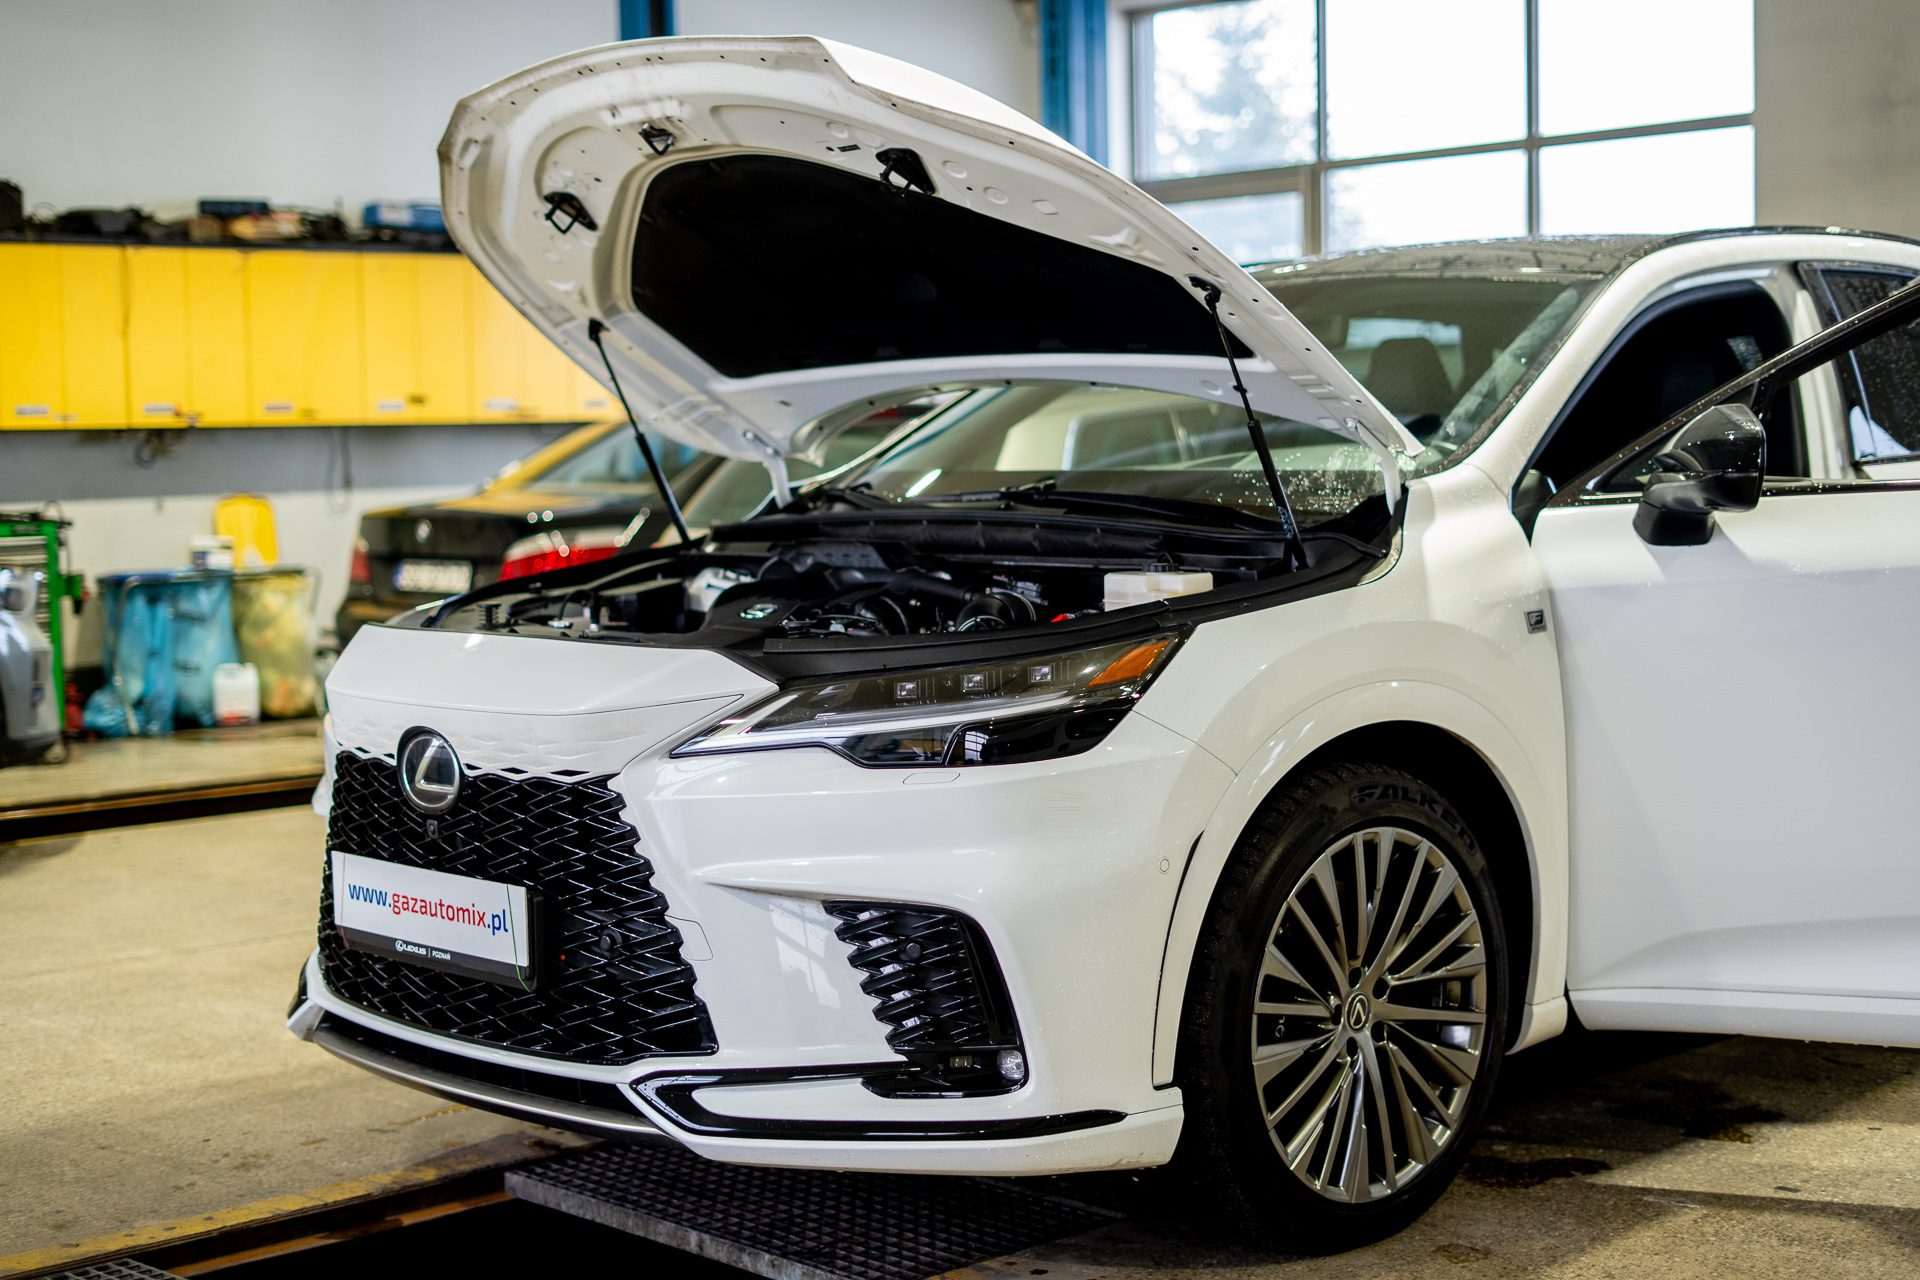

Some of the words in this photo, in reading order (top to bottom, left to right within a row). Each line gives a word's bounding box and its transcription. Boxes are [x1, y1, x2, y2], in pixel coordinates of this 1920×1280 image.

[1352, 784, 1477, 856] FALKEN
[348, 883, 509, 936] www.gazautomix.pl
[403, 943, 427, 956] LEXUS
